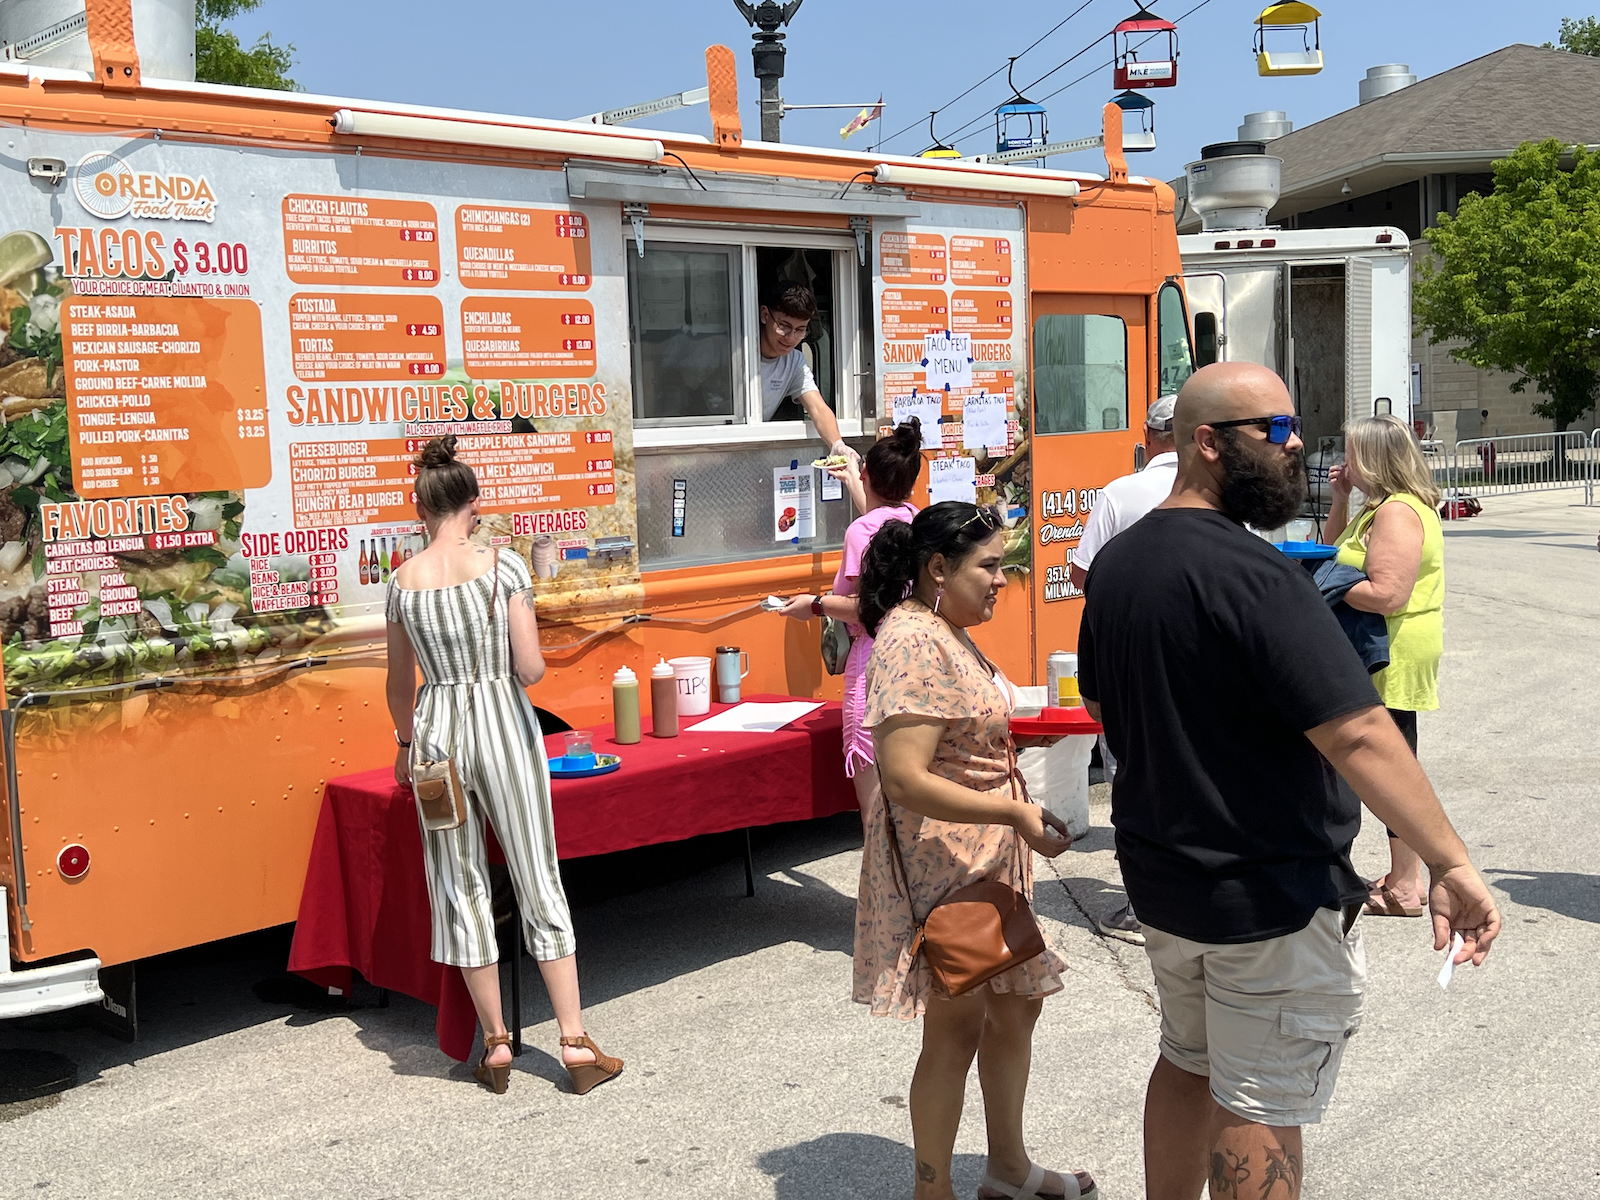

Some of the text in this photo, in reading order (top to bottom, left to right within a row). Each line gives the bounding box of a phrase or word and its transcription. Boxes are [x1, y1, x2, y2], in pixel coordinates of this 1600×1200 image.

[95, 172, 215, 202] ORENDA
[133, 200, 214, 219] Food Truck
[288, 198, 368, 216] CHICKEN FLAUTAS
[461, 209, 520, 225] CHIMICHANGAS
[56, 228, 165, 278] TACOS
[292, 238, 337, 254] BURRITOS
[464, 247, 514, 262] QUESADILLAS
[73, 280, 250, 296] YOUR CHOICE OF MEAT, CILANTRO & ONION
[70, 306, 136, 318] STEAK-ASADA
[296, 298, 336, 313] TOSTADA
[464, 312, 512, 325] ENCHILADAS
[71, 324, 180, 336] BEEF BIRRIA-BARBACOA
[422, 326, 437, 336] 4.50
[72, 342, 200, 354] MEXICAN SAUSAGE-CHORIZO
[299, 338, 334, 352] TORTAS
[465, 340, 520, 352] QUESABIRRIAS
[884, 342, 924, 362] SANDW
[926, 337, 968, 351] TACO FEST
[74, 360, 140, 372] PORK-PASTOR
[934, 358, 962, 374] MENU
[75, 376, 207, 390] GROUND BEEF-CARNE MOLIDA
[76, 395, 150, 408] CHICKEN-POLLO
[286, 378, 607, 426] SANDWICHES & BURGERS
[927, 396, 942, 404] TACO
[994, 396, 1005, 404] TACO
[78, 412, 156, 426] TONGUE-LENGUA
[406, 420, 512, 435] ALL SERVED WITH WAFFLE FRIES
[80, 428, 190, 444] PULLED PORK-CARNITAS
[455, 436, 500, 450] PINEAPPLE
[502, 436, 525, 448] PORK
[527, 434, 571, 446] SANDWICH
[594, 433, 610, 442] 10.00
[291, 442, 368, 458] CHEESEBURGER
[81, 458, 94, 466] ADD
[94, 456, 122, 466] AVOCADO
[487, 464, 508, 478] MELT
[510, 462, 554, 476] SANDWICH
[596, 460, 612, 470] 10.00
[932, 460, 970, 471] STEAK TACO
[82, 469, 94, 477] ADD
[96, 468, 111, 476] SOUR
[112, 467, 133, 476] CREAM
[293, 465, 376, 482] CHORIZO BURGER
[82, 480, 95, 489] ADD
[96, 479, 119, 488] CHEESE
[498, 484, 542, 499] SANDWICH
[598, 484, 614, 494] 10.00
[296, 496, 337, 512] HUNGRY
[339, 494, 364, 509] BEAR
[366, 491, 404, 507] BURGER
[1042, 488, 1076, 518] (414)
[42, 496, 188, 541] FAVORITES
[514, 511, 586, 535] BEVERAGES
[1040, 518, 1084, 542] Orenda
[45, 542, 92, 557] CARNITAS
[94, 542, 107, 554] OR
[108, 538, 144, 552] LENGUA
[184, 532, 214, 546] EXTRA
[241, 532, 280, 558] SIDE
[284, 527, 348, 554] ORDERS
[46, 556, 118, 574] MEAT CHOICES:
[251, 559, 268, 570] RICE
[252, 572, 278, 584] BEANS
[1047, 566, 1070, 582] 3514
[48, 574, 126, 592] STEAK PORK
[252, 586, 272, 598] RICE
[272, 586, 278, 595] &
[282, 583, 307, 594] BEANS
[48, 586, 137, 607] CHORIZO GROUND
[252, 598, 286, 612] WAFFLE
[286, 595, 309, 608] FRIES
[50, 601, 141, 622] BEEF CHICKEN
[51, 622, 83, 637] BIRRIA
[676, 676, 707, 695] TIPS
[103, 994, 126, 1018] Olson
